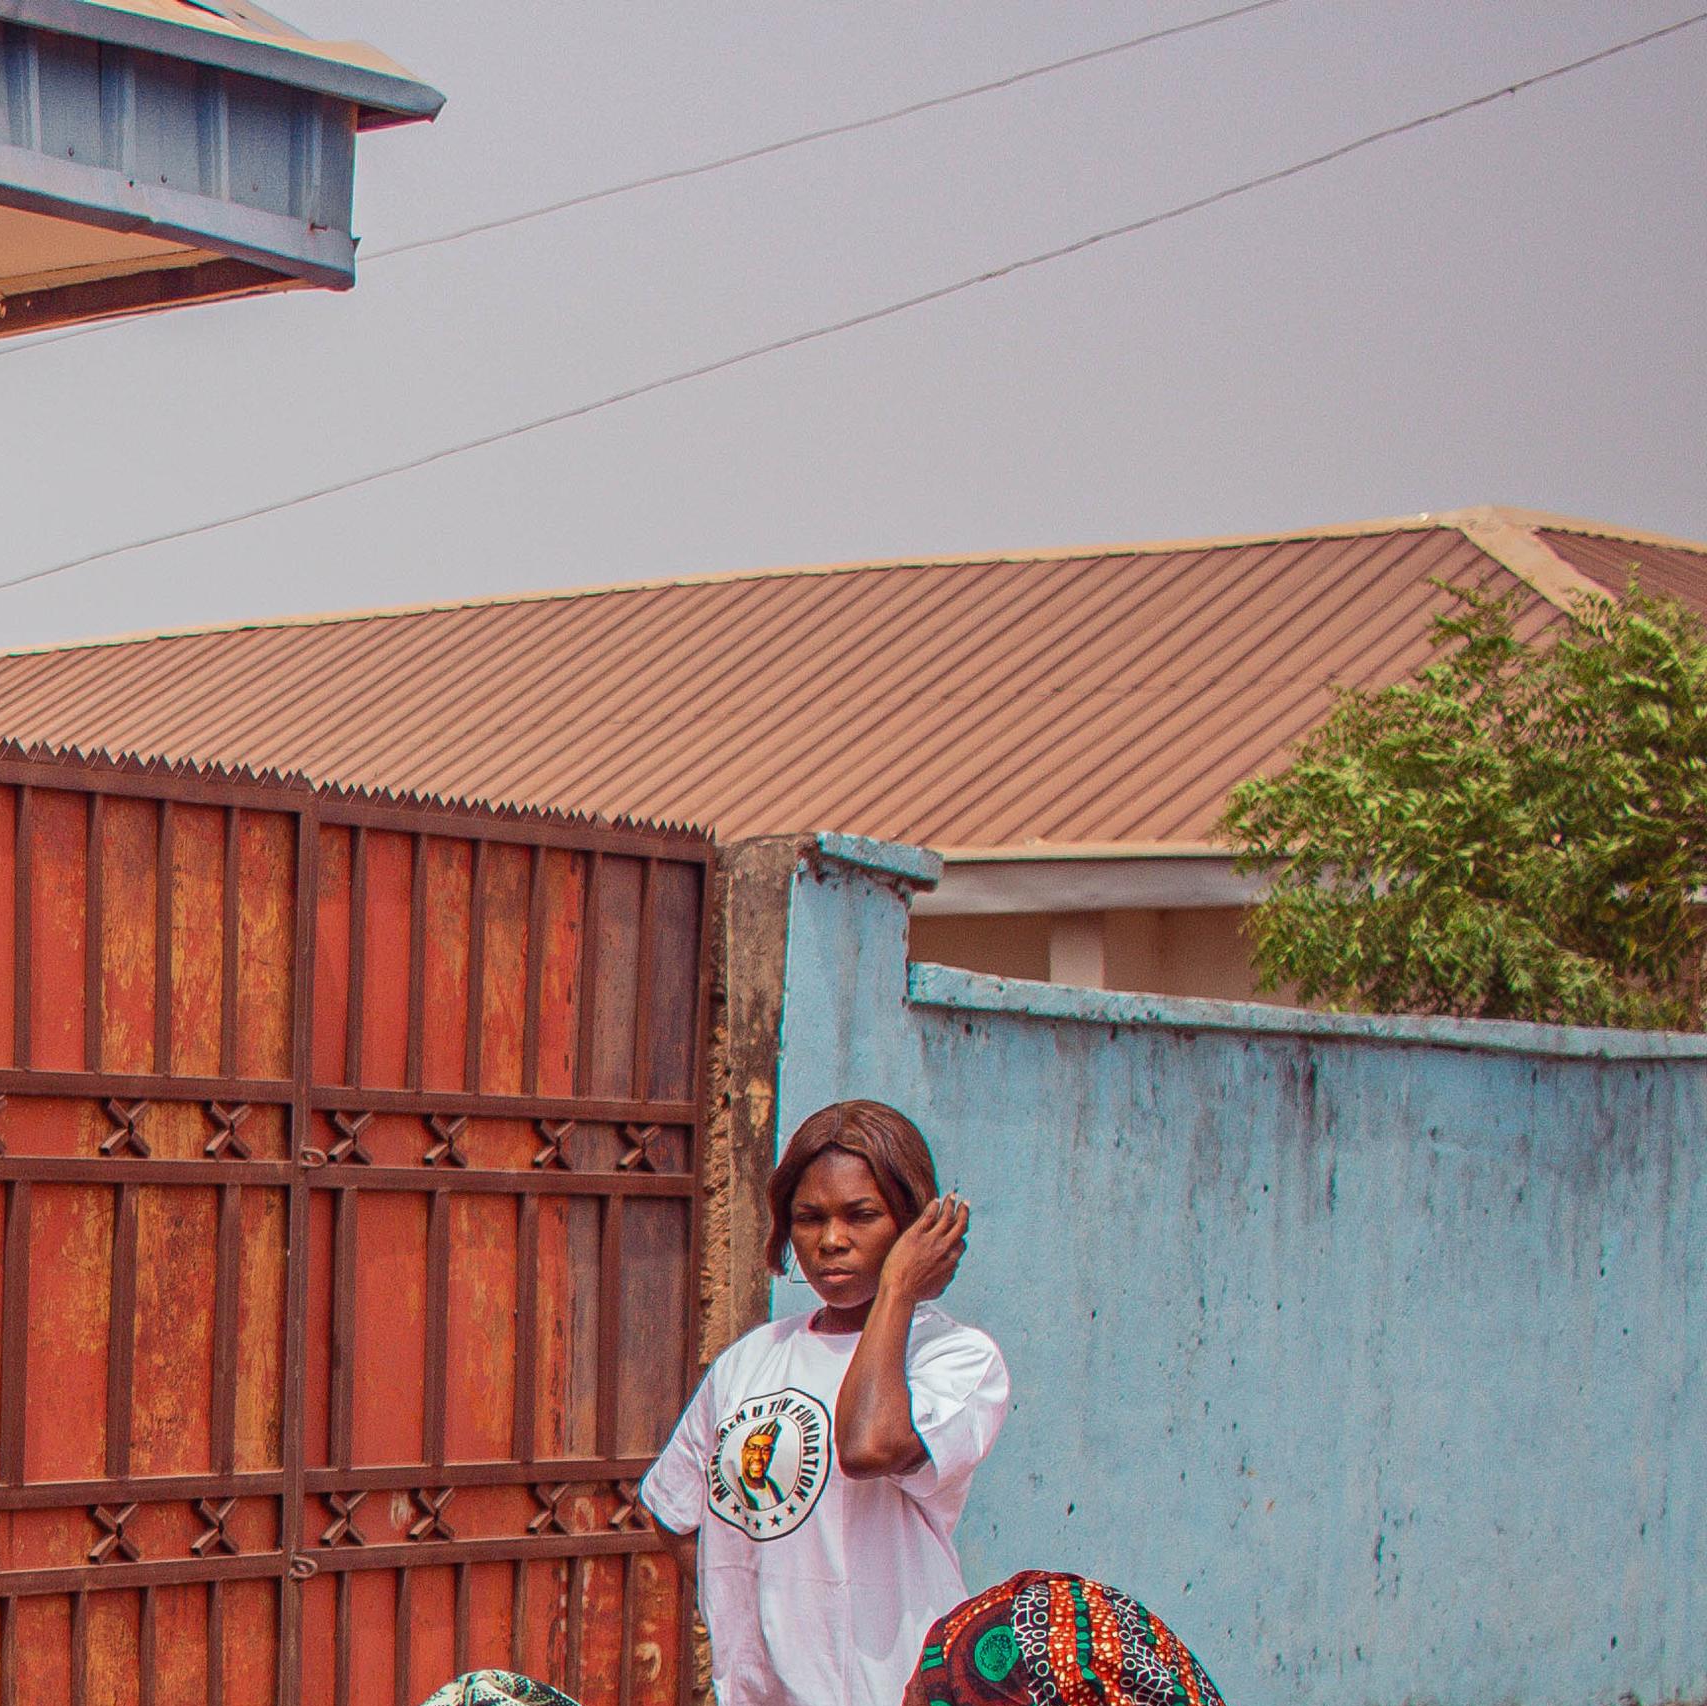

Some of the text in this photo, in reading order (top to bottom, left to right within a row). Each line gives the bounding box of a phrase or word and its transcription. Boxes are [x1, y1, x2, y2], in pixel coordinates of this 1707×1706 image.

[751, 1404, 764, 1418] U
[769, 1397, 795, 1414] TIV
[789, 1404, 820, 1503] FOUNDATION
